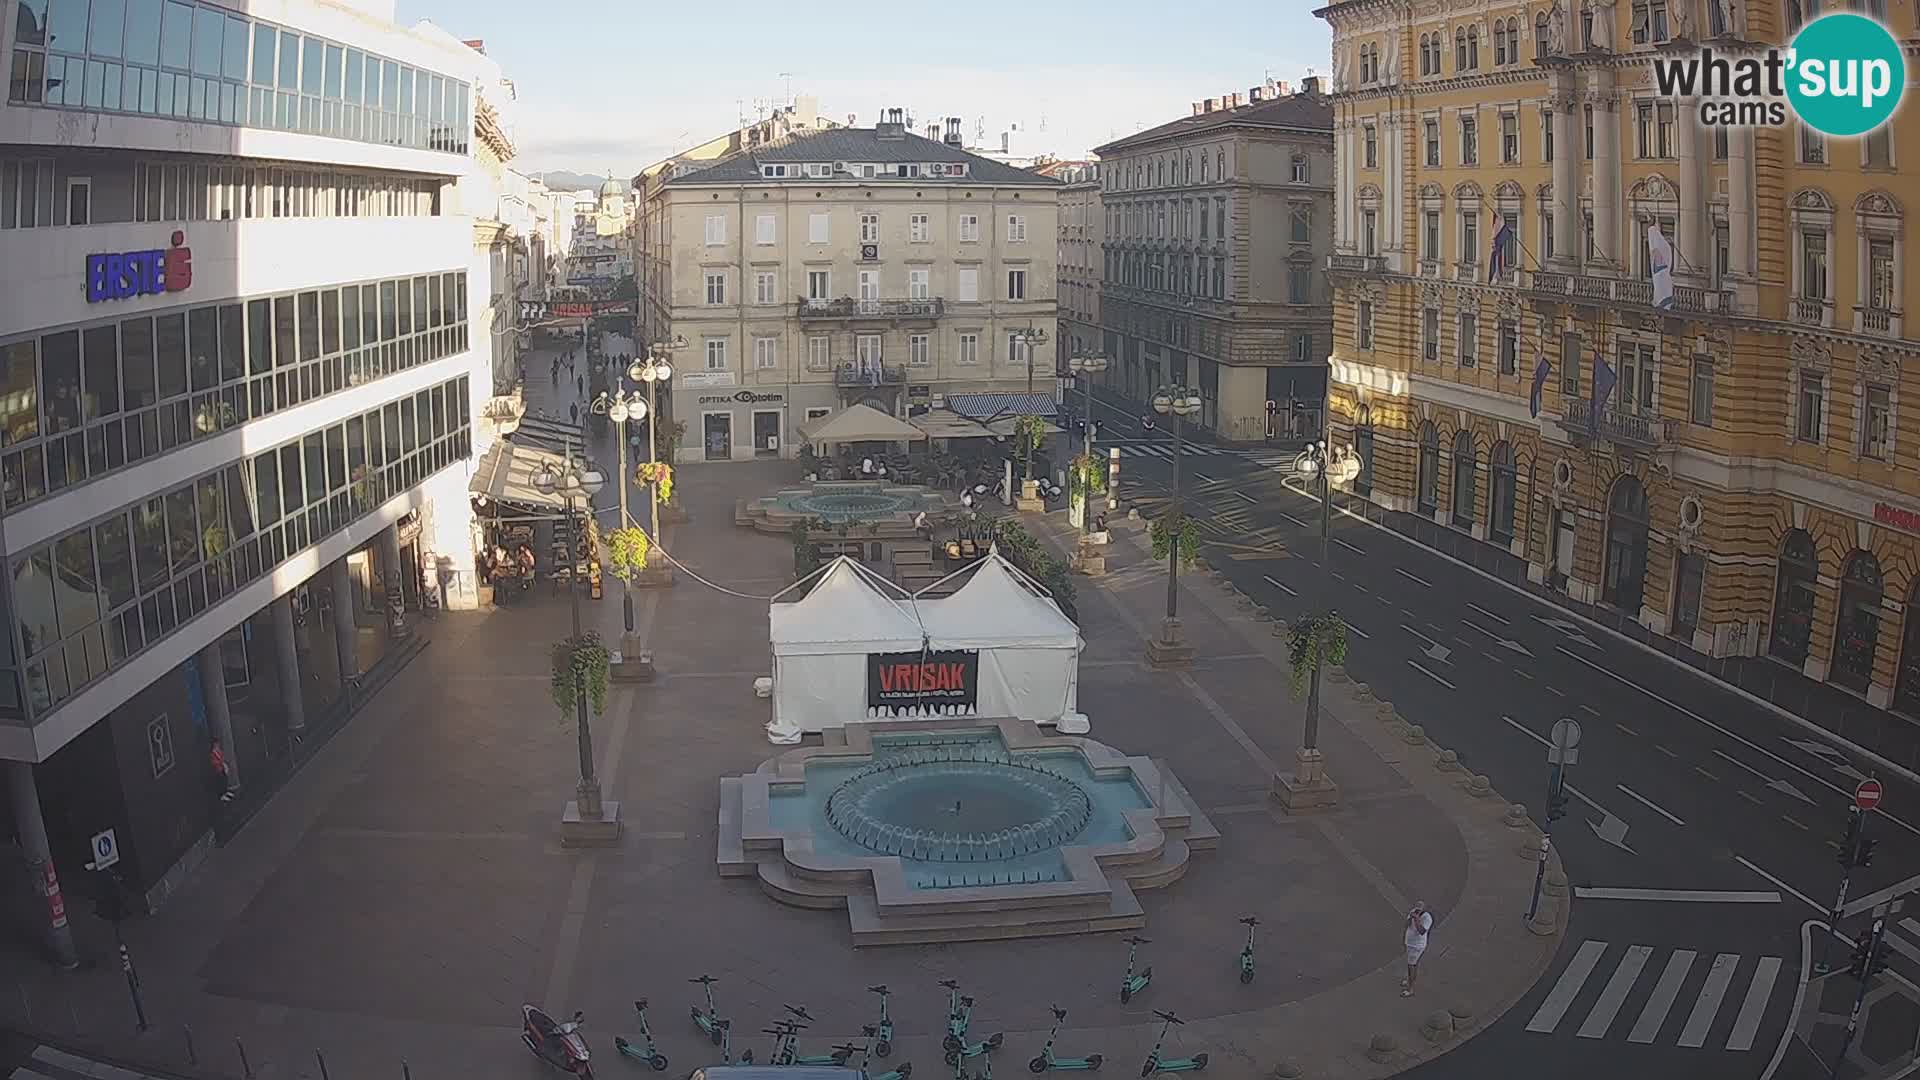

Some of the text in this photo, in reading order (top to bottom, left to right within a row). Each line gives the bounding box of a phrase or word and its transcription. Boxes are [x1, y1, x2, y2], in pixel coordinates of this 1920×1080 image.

[86, 249, 165, 303] ERSTE
[699, 396, 731, 404] OPTIKA
[880, 663, 965, 691] VRISAK
